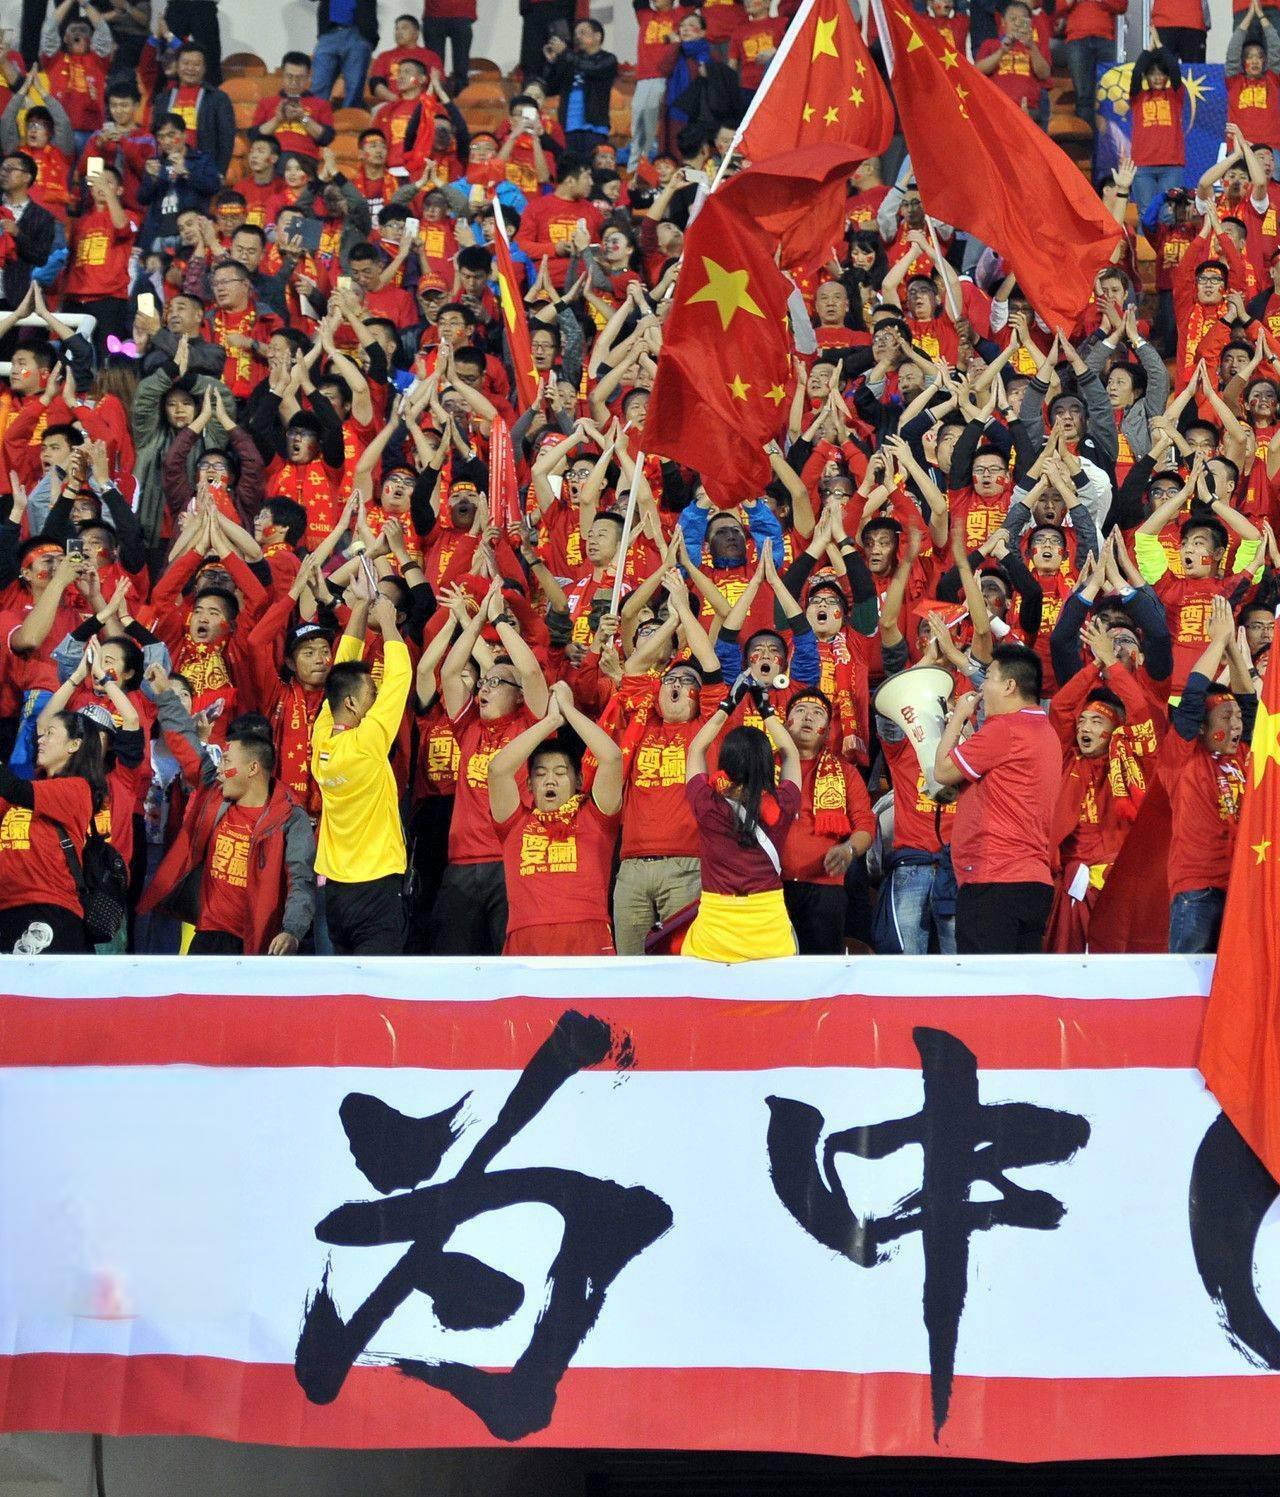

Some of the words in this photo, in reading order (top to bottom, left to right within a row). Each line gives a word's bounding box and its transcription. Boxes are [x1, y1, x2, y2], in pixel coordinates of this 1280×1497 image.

[1180, 604, 1213, 634] 要
[636, 743, 687, 778] 要赢
[211, 833, 251, 877] 要赢
[520, 833, 577, 864] 要赢
